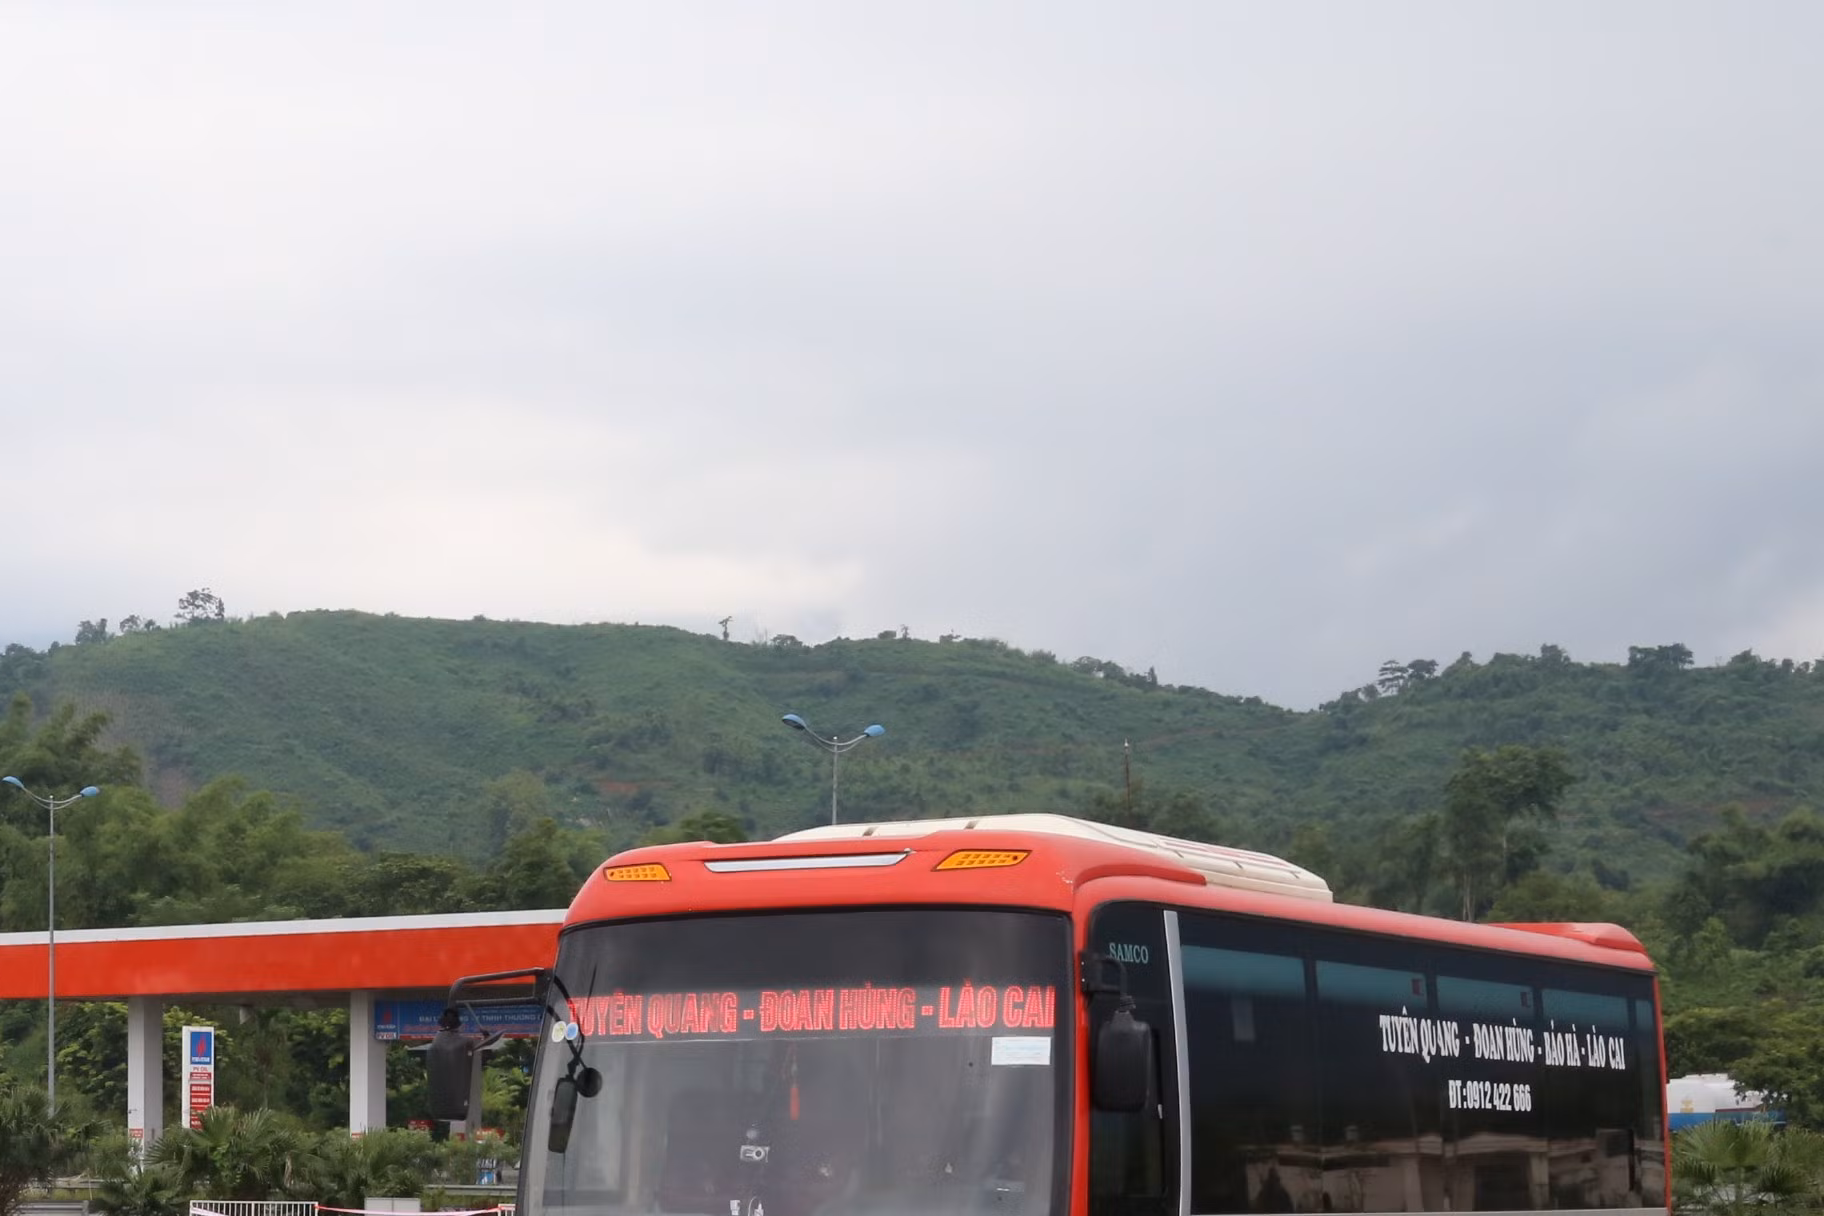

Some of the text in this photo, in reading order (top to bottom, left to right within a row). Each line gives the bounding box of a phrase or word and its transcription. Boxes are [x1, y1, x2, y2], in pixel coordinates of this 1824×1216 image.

[1109, 942, 1149, 964] SAMCO
[647, 991, 737, 1039] QUANG
[760, 989, 834, 1032] ĐOAN
[1002, 985, 1056, 1029] CAI
[1379, 1005, 1419, 1054] TUYÊN
[1420, 1018, 1460, 1063] QUANG
[1472, 1022, 1505, 1061] ĐOAN
[1505, 1017, 1535, 1063] HÙNG
[1564, 1023, 1581, 1067] HÀ
[1586, 1024, 1607, 1068] LÀO
[1608, 1037, 1626, 1070] CAI
[1493, 1083, 1512, 1111] 422
[1513, 1084, 1532, 1112] 666
